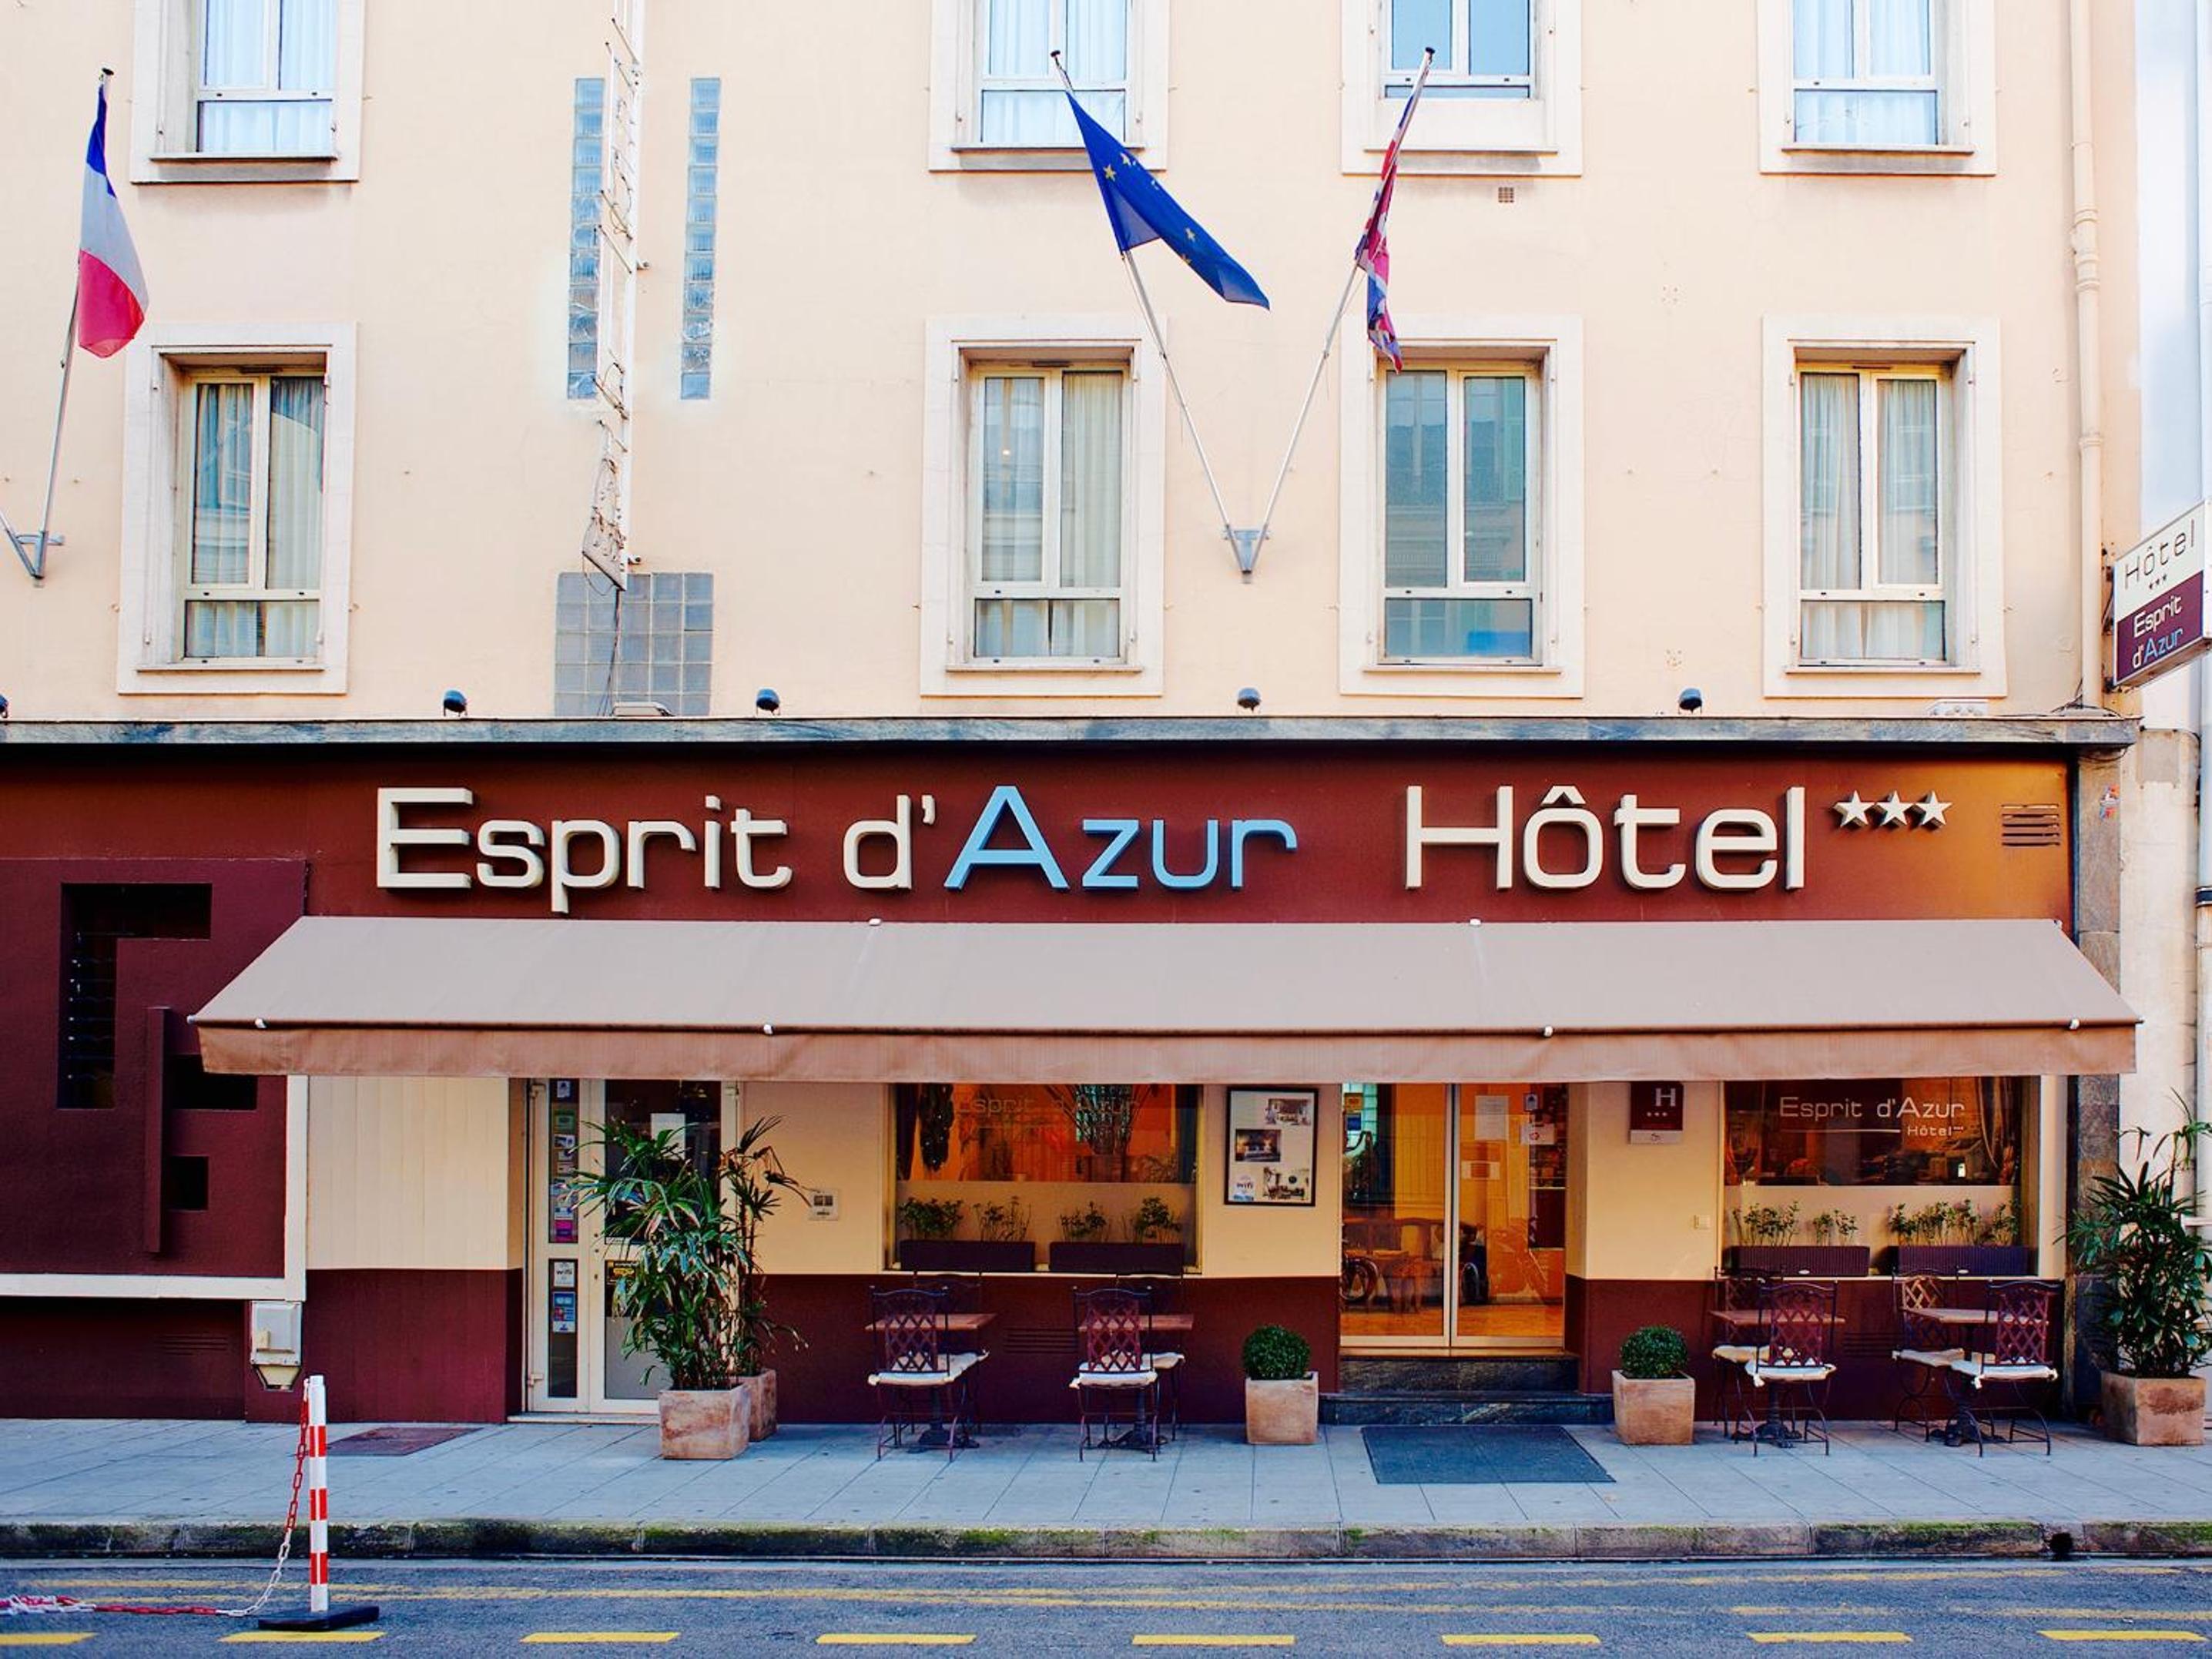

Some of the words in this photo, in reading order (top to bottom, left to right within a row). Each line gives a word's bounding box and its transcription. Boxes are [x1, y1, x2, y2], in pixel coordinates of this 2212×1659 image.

[2124, 518, 2195, 590] Hôtel
[2133, 595, 2183, 638] Esprit
[2132, 627, 2184, 669] d'Azur
[377, 786, 793, 913] Esprit
[843, 785, 1298, 890] d'Azur
[1406, 785, 1805, 891] Hôtel
[1655, 1088, 1676, 1107] H
[1778, 1096, 1862, 1121] Esprit
[1876, 1096, 1965, 1118] d'Azur
[1907, 1124, 1952, 1136] Hôtel
